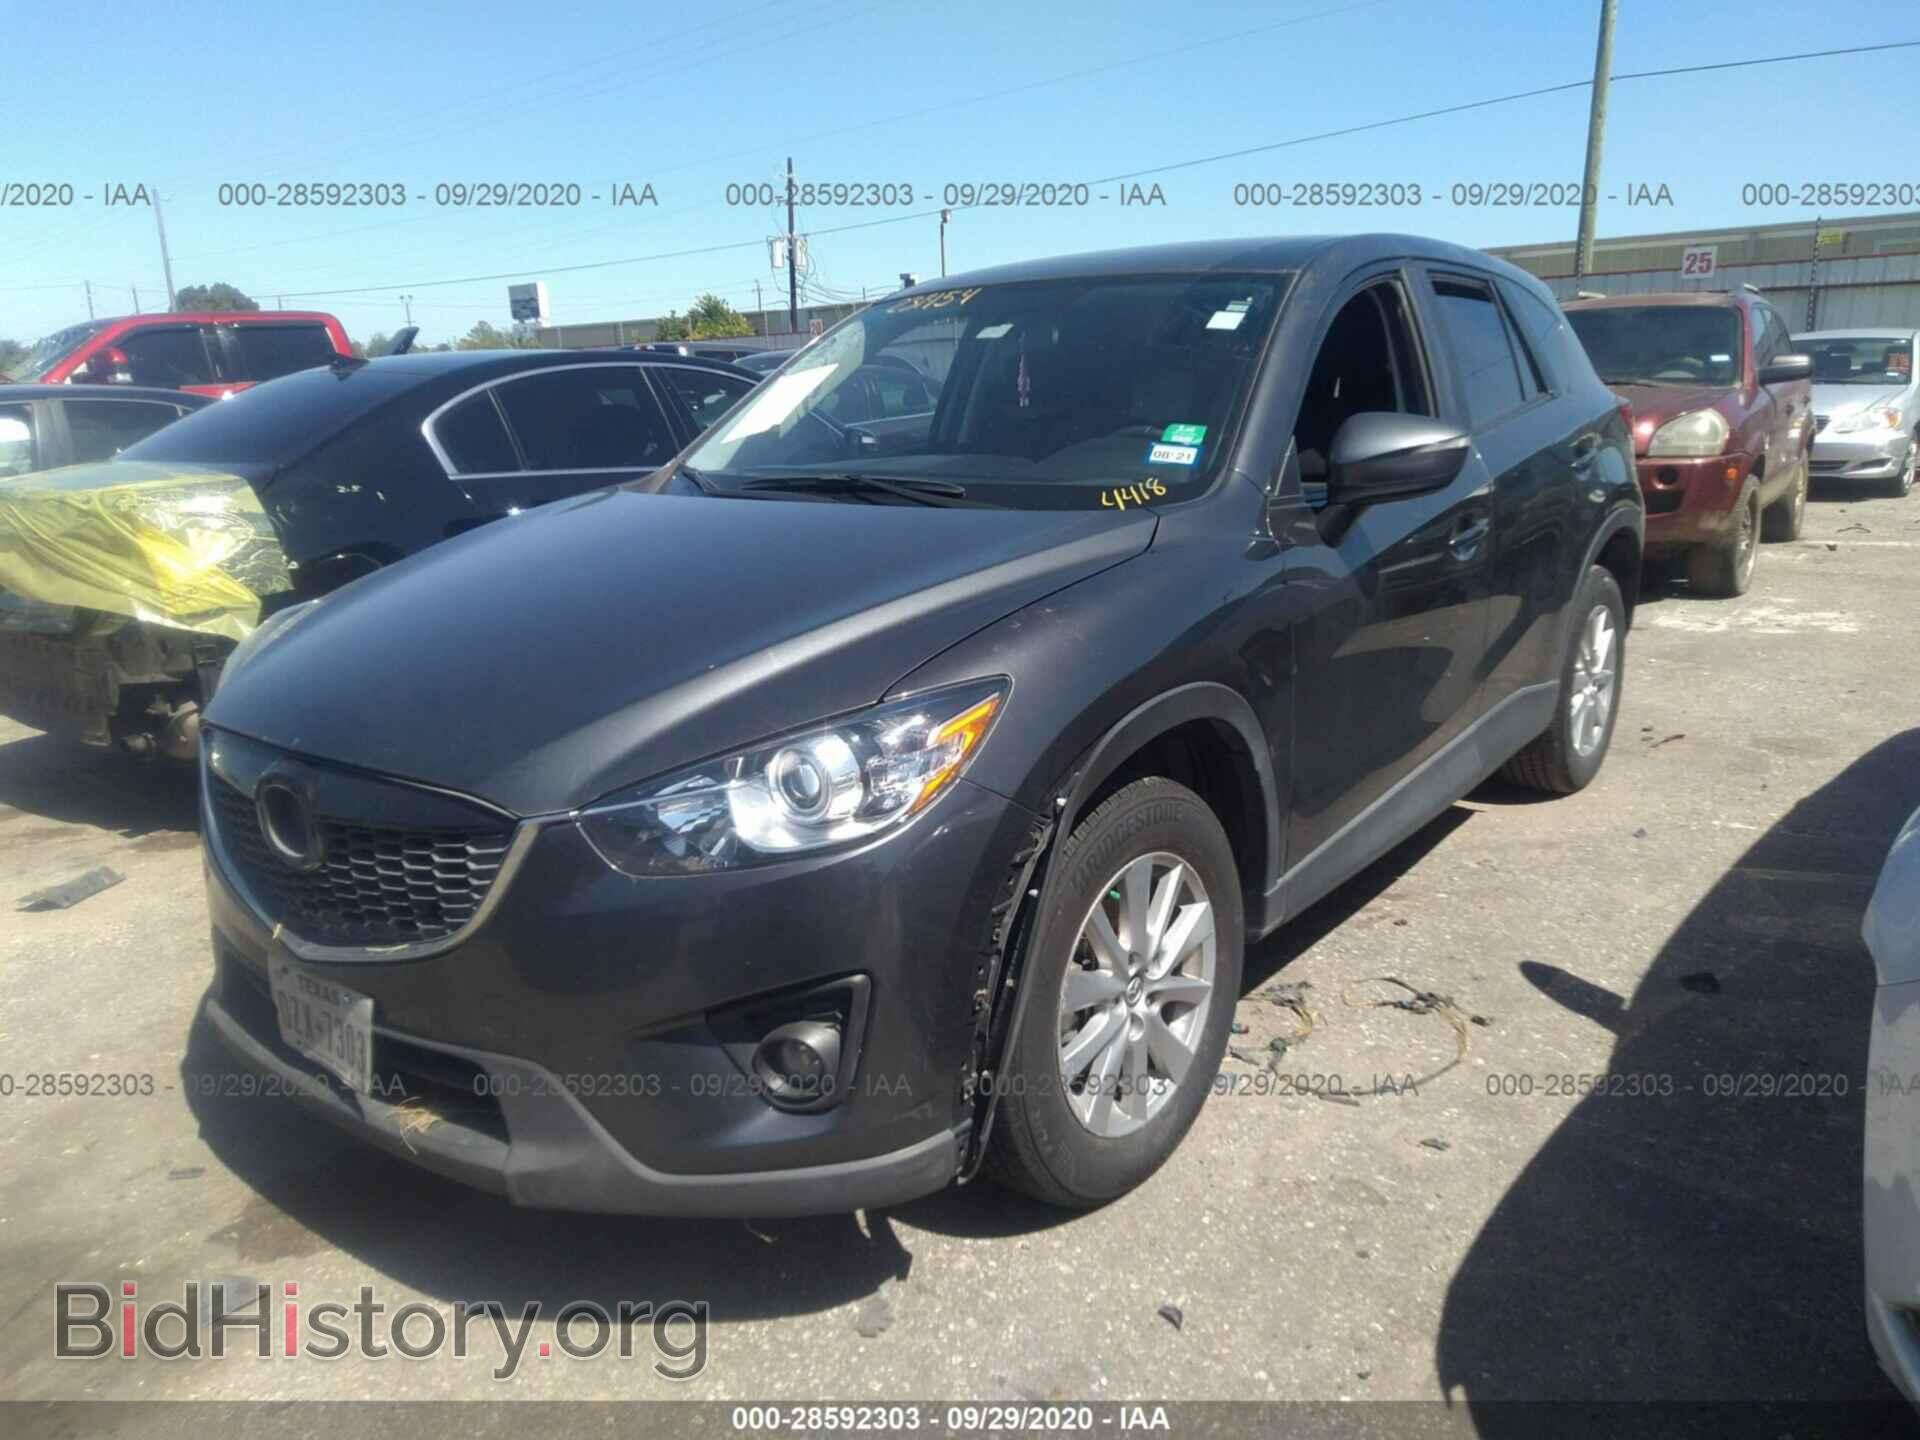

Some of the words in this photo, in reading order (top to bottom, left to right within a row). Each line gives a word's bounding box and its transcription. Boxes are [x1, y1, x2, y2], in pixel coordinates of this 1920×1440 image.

[1684, 253, 1713, 274] 25
[1101, 478, 1166, 511] 4418
[297, 974, 339, 1006] TEXAS
